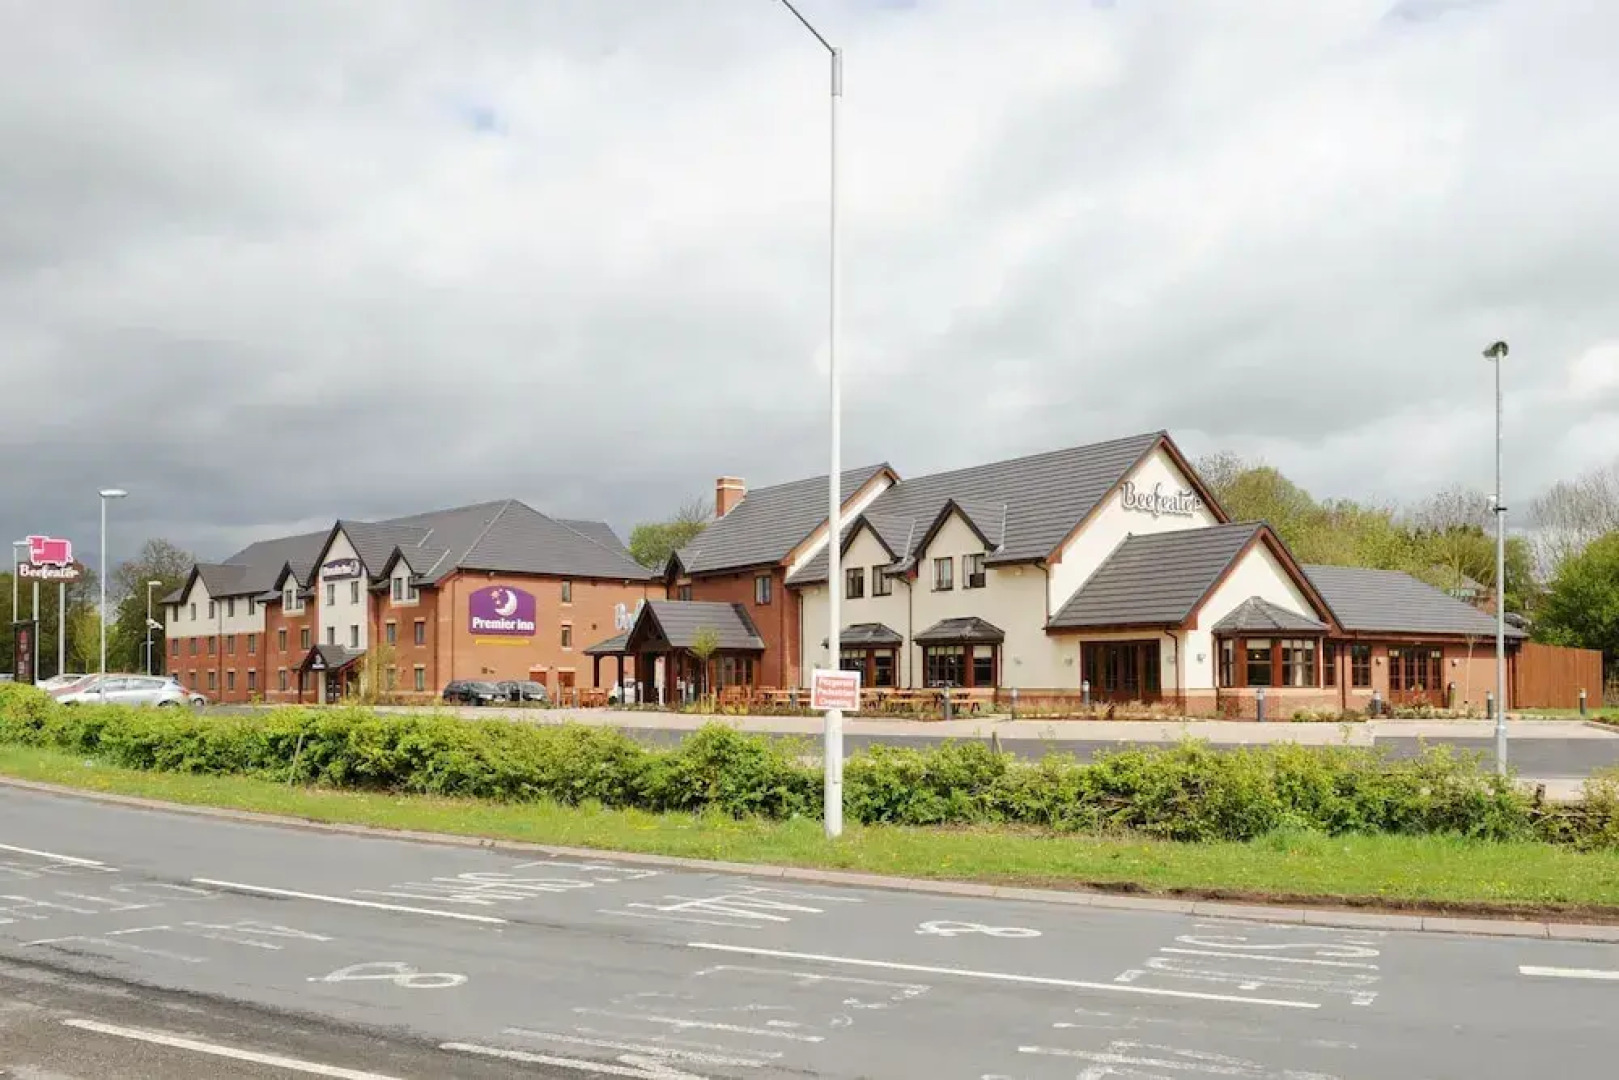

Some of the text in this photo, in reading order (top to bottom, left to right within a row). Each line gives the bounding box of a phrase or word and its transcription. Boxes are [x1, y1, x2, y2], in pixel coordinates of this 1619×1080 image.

[1122, 481, 1202, 517] Beefeater
[472, 616, 534, 631] Premier Inn
